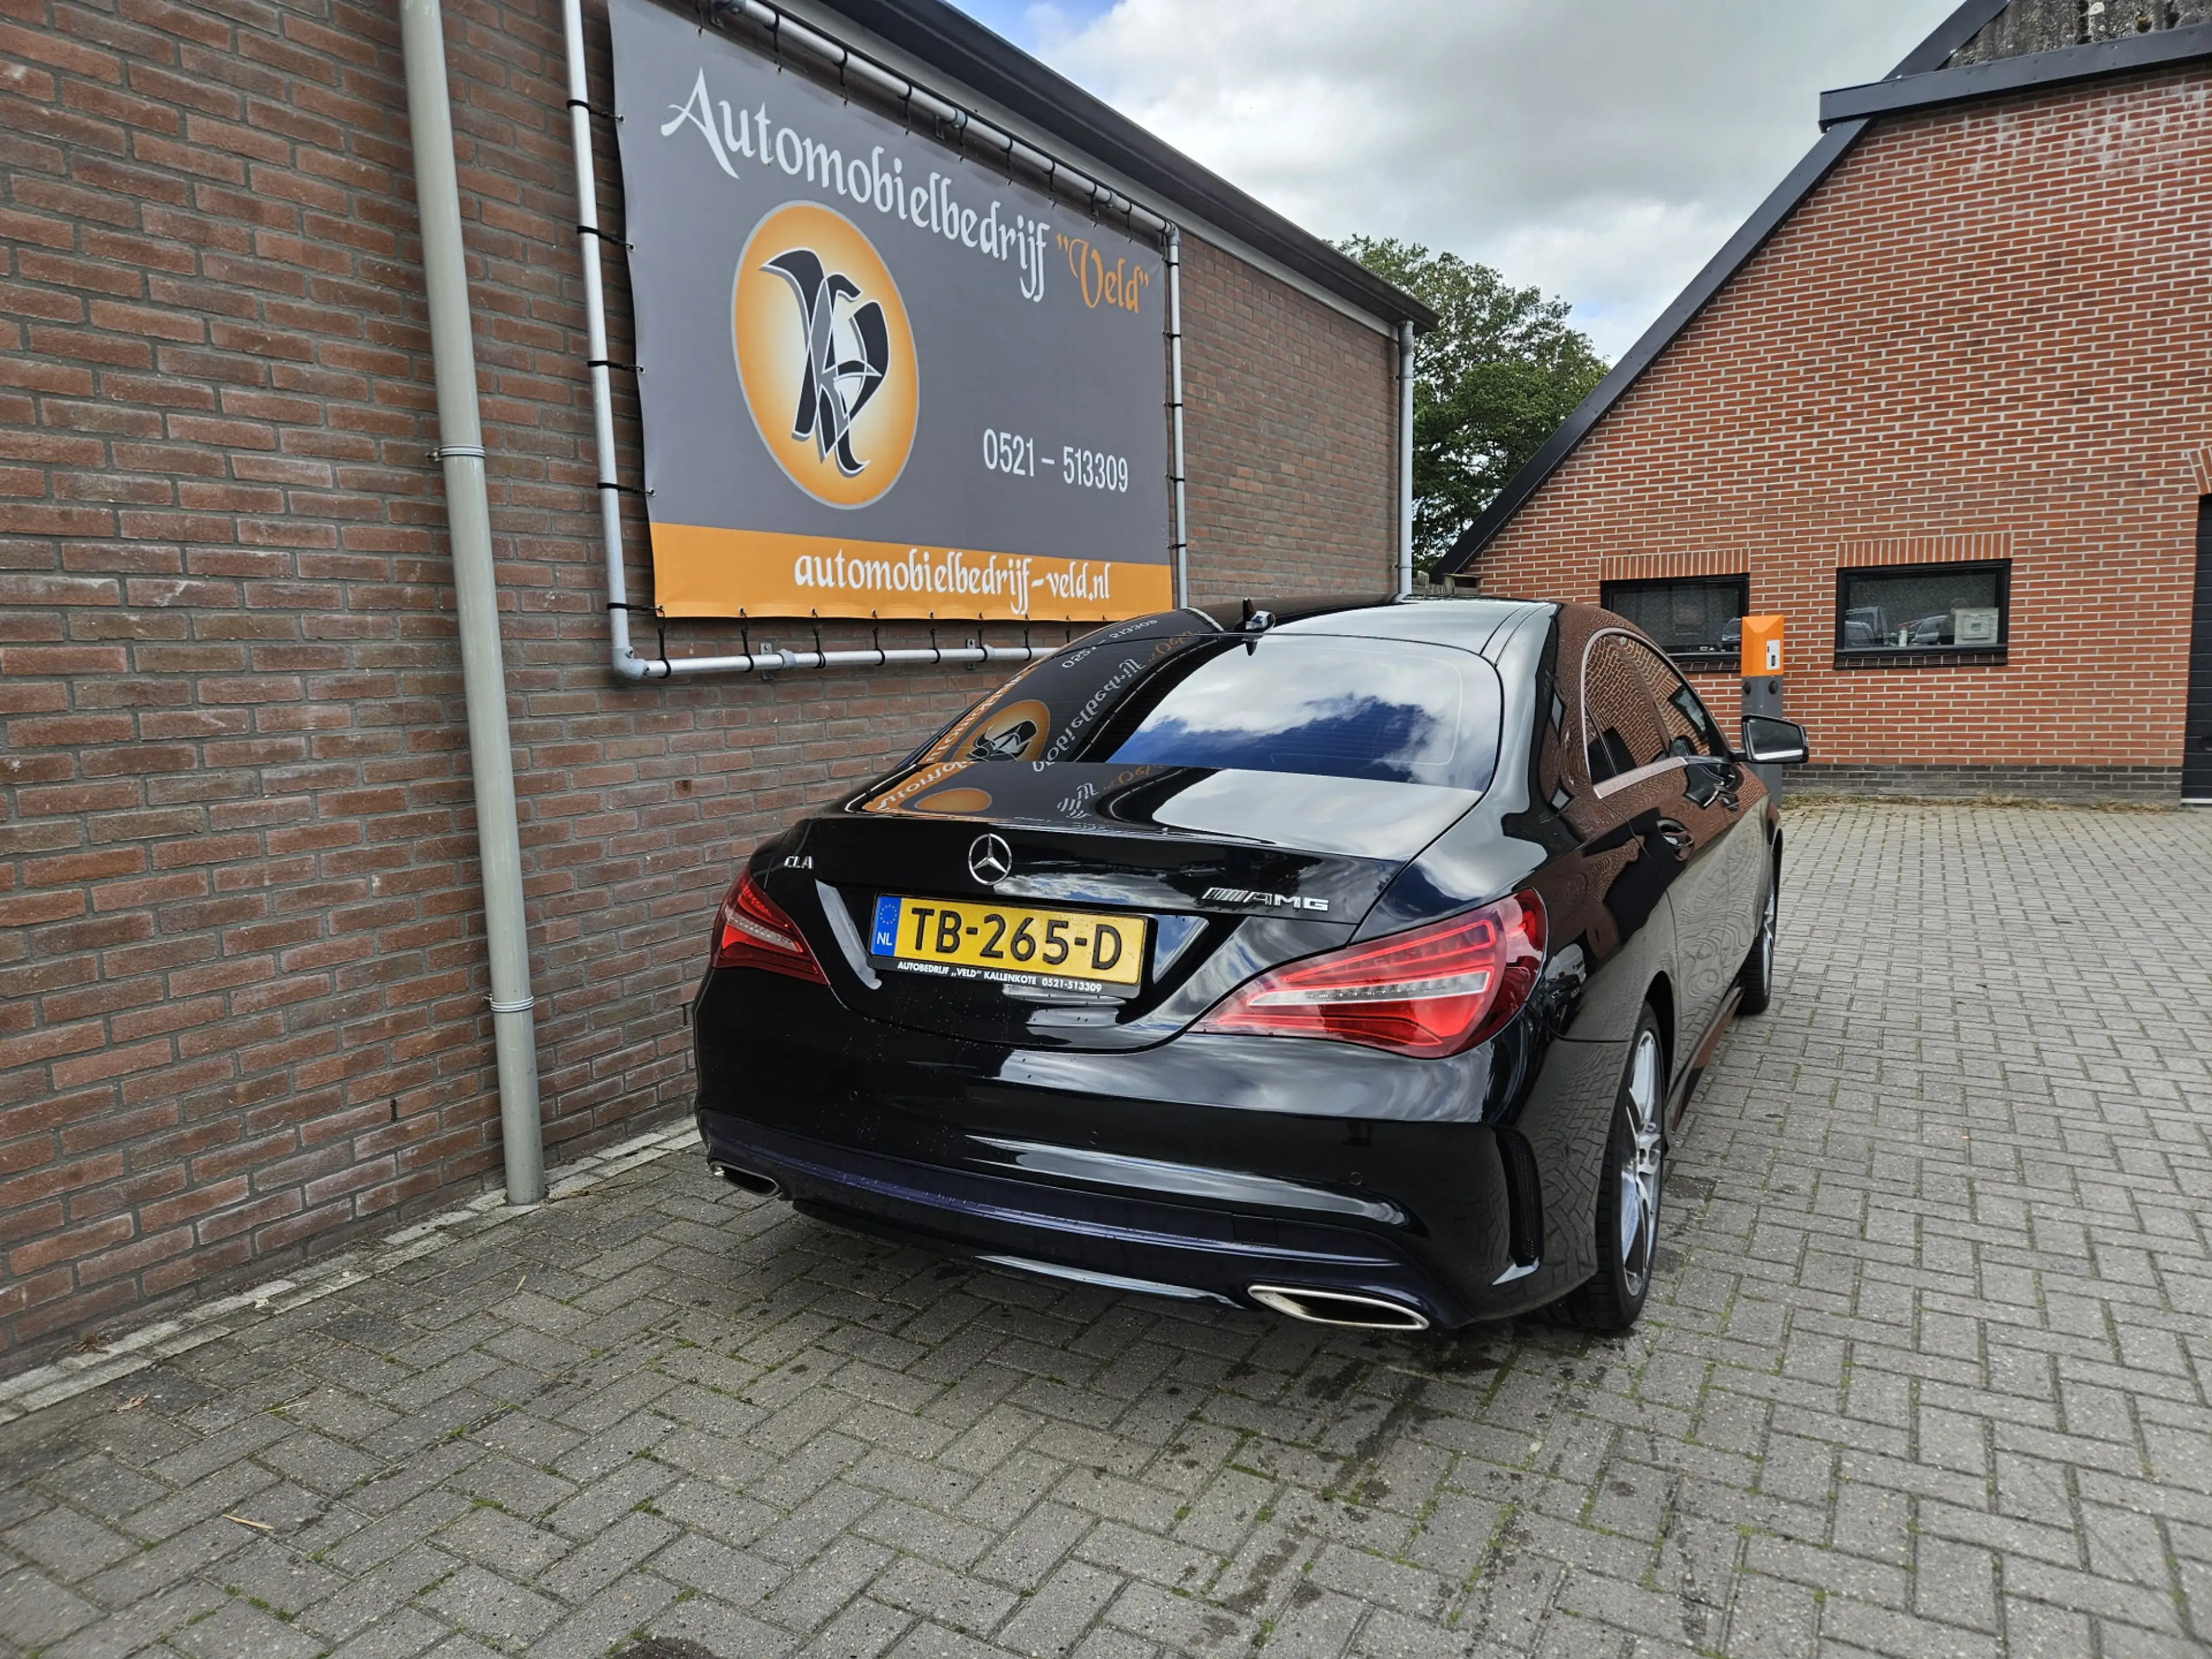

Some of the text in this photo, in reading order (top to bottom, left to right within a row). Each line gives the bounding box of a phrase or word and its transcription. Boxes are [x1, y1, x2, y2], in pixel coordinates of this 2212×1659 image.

[661, 67, 1050, 302] Automobielbedrijf
[983, 428, 1035, 477] 0521
[1063, 446, 1128, 493] 513309
[794, 548, 1111, 616] automobielbedrijf-veld.nl
[784, 856, 813, 869] CLA
[1243, 891, 1329, 911] AMG
[876, 931, 893, 946] NL
[911, 907, 1122, 970] TB-265-D
[897, 961, 950, 975] AUTOBEDRIJF
[983, 971, 1036, 985] KALLENKOTE
[1041, 977, 1102, 993] 0521-513309
